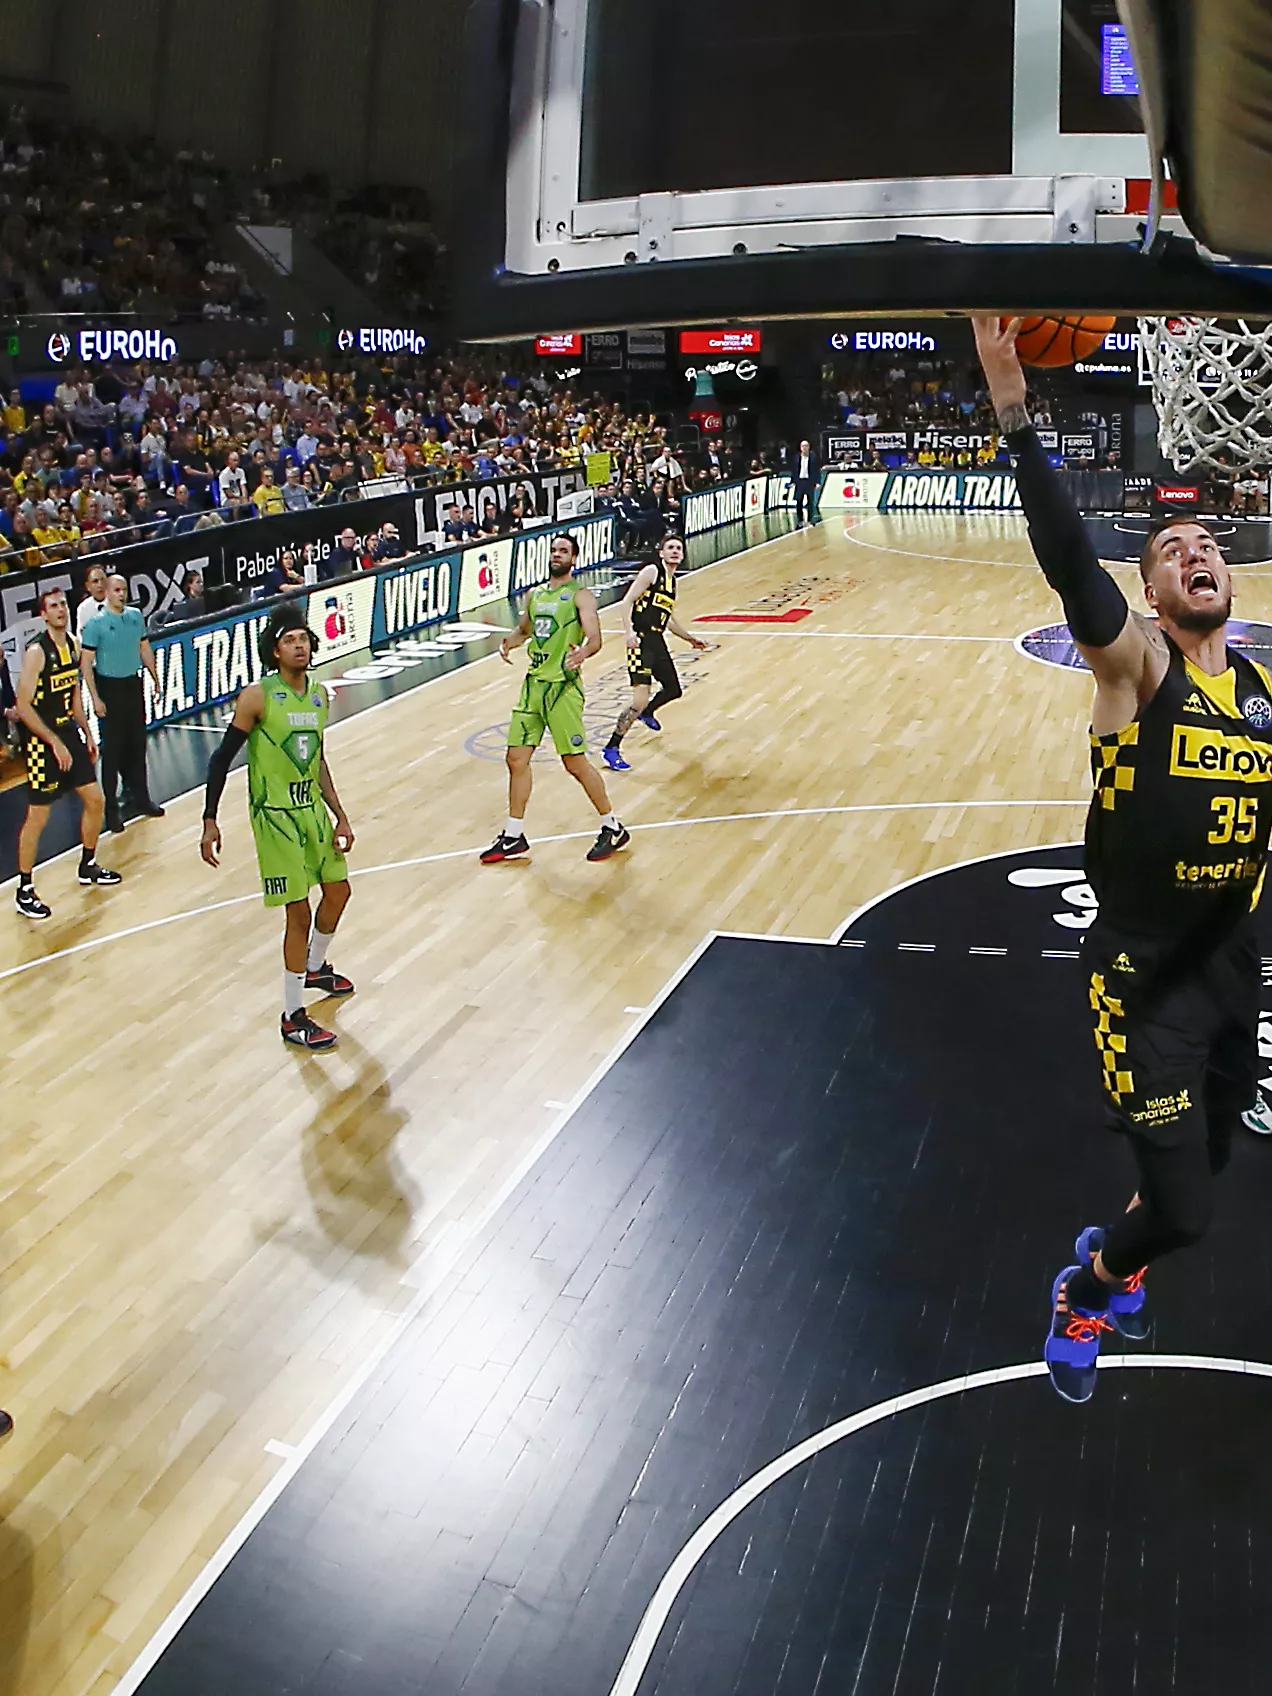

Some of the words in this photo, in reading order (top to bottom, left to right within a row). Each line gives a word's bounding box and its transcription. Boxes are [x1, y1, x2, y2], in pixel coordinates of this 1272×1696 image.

[887, 475, 1023, 507] ARONA.TRAV
[1160, 490, 1195, 499] Lenovo
[535, 618, 552, 638] 22
[298, 735, 309, 760] 5
[1207, 795, 1258, 844] 35
[264, 876, 288, 895] FIAT
[1146, 1095, 1175, 1110] Islas
[1130, 1105, 1177, 1122] anarias
